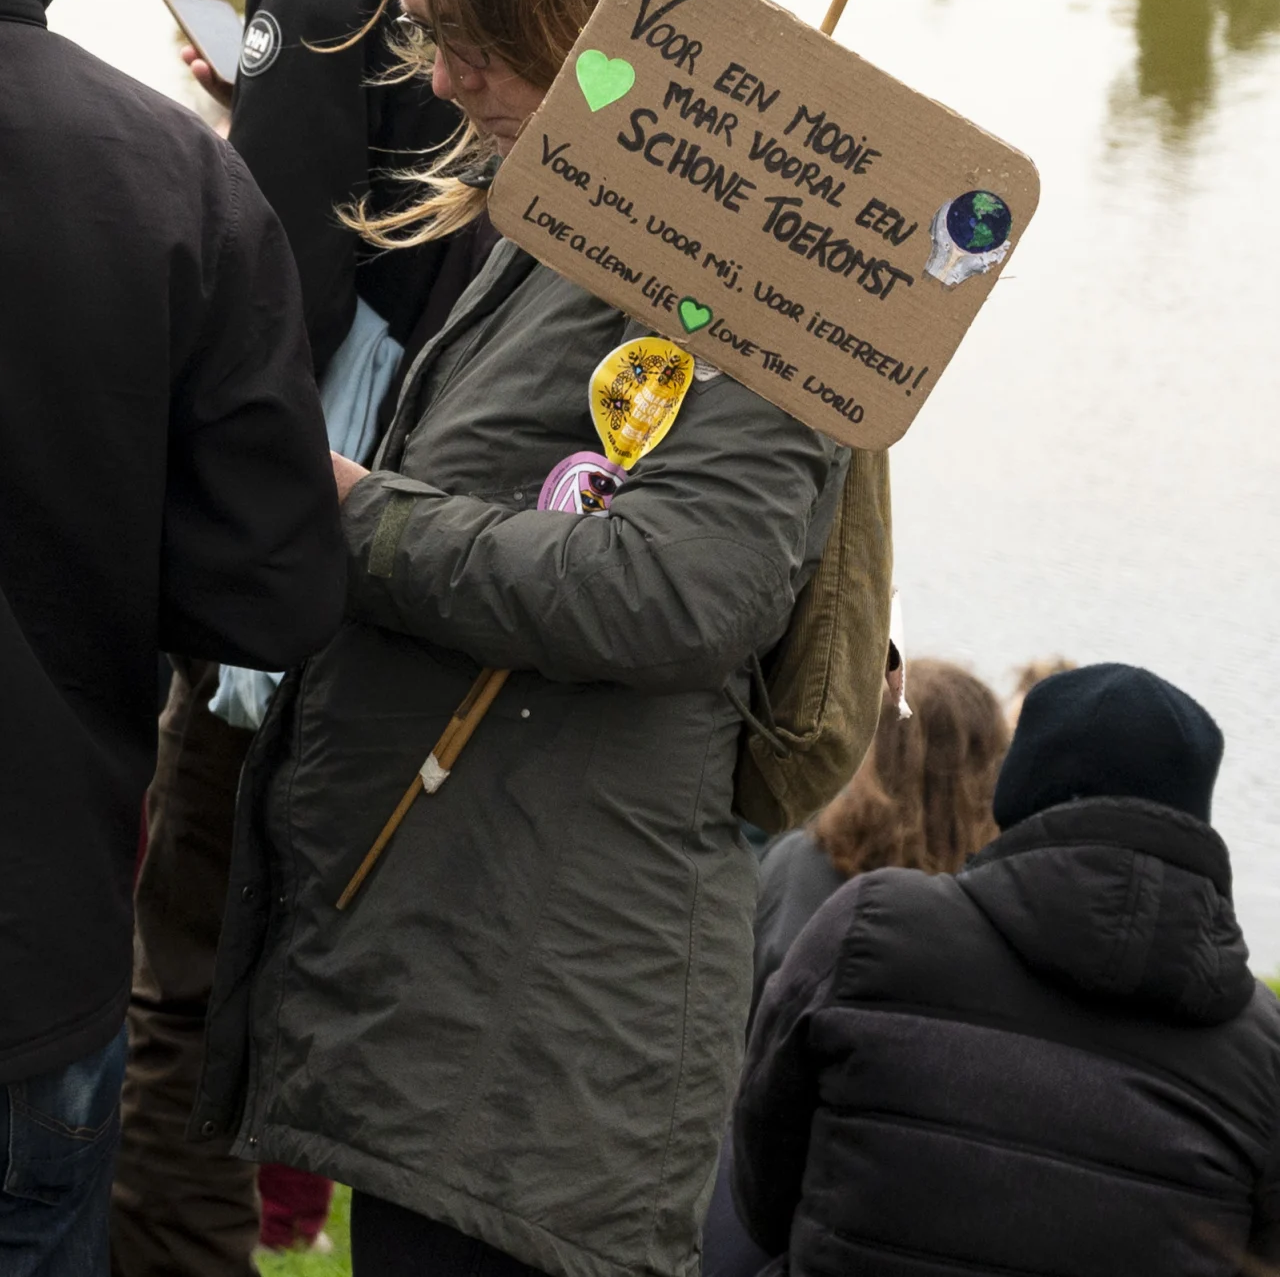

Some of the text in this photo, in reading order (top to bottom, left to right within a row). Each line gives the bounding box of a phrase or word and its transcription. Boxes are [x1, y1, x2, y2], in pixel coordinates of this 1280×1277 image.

[713, 62, 781, 113] EEN
[616, 108, 915, 300] SCHONE TOEKOMST
[662, 80, 918, 247] MAAR VOORAL EEN
[707, 318, 761, 358] LOVE
[758, 349, 800, 382] THE
